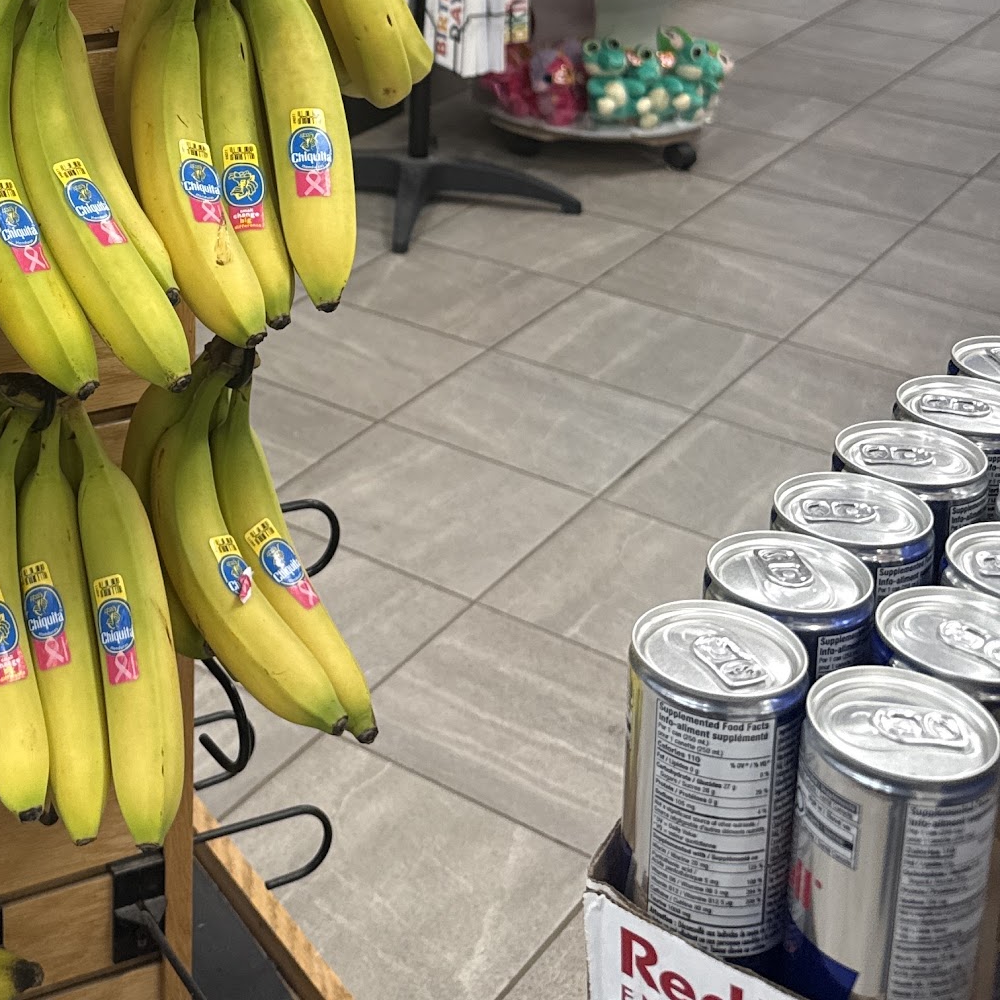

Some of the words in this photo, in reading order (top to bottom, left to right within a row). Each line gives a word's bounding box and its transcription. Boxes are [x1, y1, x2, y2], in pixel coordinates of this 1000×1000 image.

[291, 151, 332, 164] Chiquita
[183, 180, 221, 196] Chiquita
[75, 202, 111, 218] Chiquita
[1, 226, 39, 242] Chiquita
[28, 611, 64, 632] Chiquita
[101, 625, 134, 645] Chiquita
[659, 701, 720, 730] Supplemented
[722, 722, 745, 732] Food
[746, 721, 769, 731] Facts
[712, 732, 769, 744] supplémenté
[657, 740, 685, 758] Calories
[687, 753, 701, 763] 110
